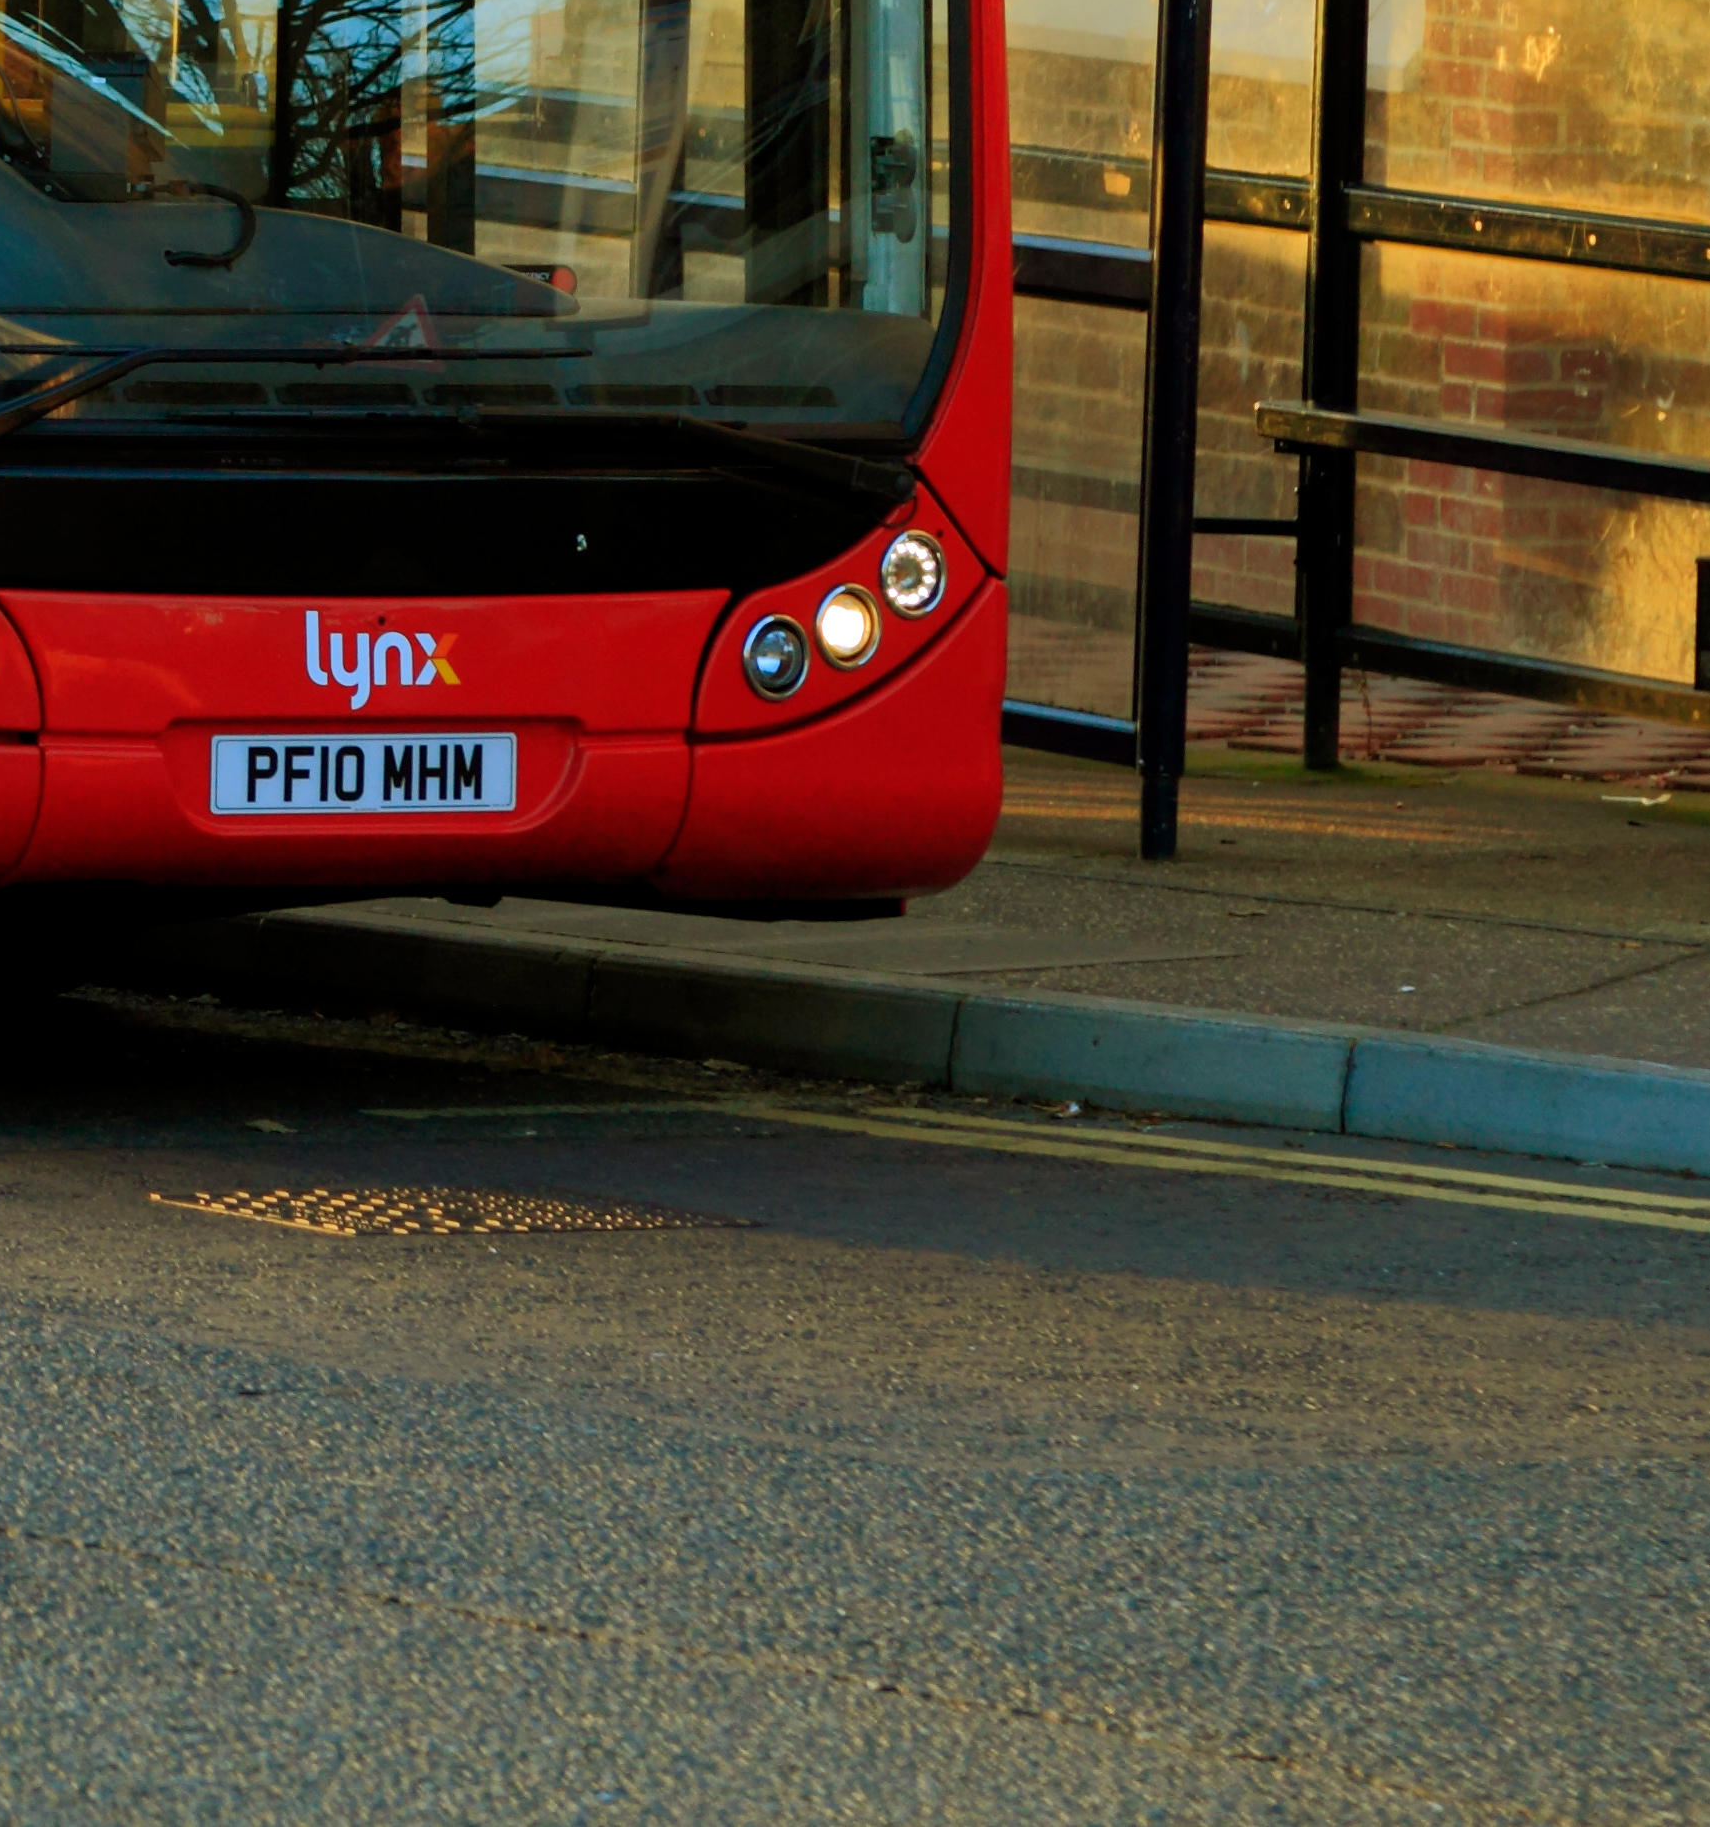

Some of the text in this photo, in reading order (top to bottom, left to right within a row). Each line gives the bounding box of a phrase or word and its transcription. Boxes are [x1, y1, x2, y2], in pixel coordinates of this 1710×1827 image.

[304, 610, 462, 711] lynx
[246, 744, 483, 803] PF10 MHM
